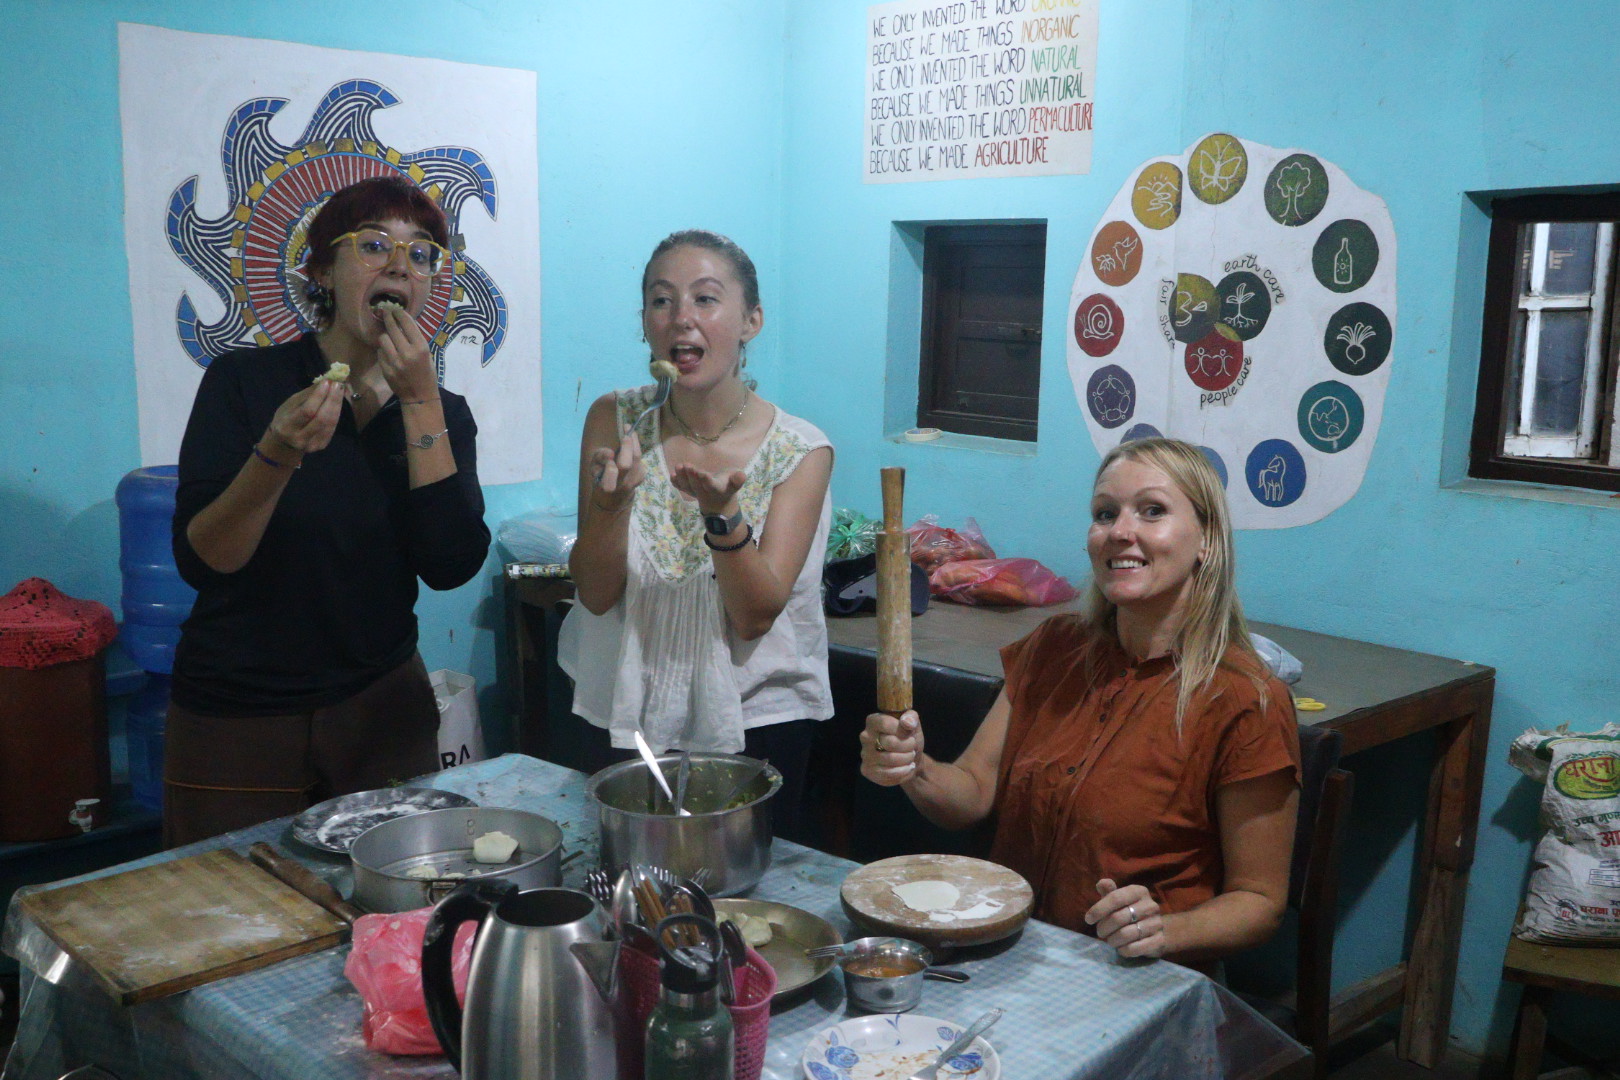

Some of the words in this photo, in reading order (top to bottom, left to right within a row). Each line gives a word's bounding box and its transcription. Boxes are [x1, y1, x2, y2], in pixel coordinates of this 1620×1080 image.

[872, 37, 915, 66] BECAUSE
[920, 33, 936, 55] WE
[941, 29, 970, 54] MADE
[977, 20, 1014, 48] THINGS
[1021, 14, 1081, 43] INORGANIC
[873, 16, 886, 37] WE
[893, 13, 917, 35] ONLY
[922, 2, 966, 28] INVENTED
[970, 0, 987, 20] THE
[872, 69, 886, 92] WE
[890, 63, 916, 90] ONLY
[920, 56, 966, 85] INVENTED
[969, 54, 989, 79] THE
[994, 47, 1026, 75] WORD
[1031, 45, 1081, 74] NATURAL
[871, 92, 914, 120] BECAUSE
[919, 90, 933, 115] WE
[939, 85, 967, 112] MADE
[974, 78, 1015, 108] THINGS
[1020, 72, 1087, 104] UNNATURAL
[871, 123, 885, 146] WE
[891, 119, 917, 145] ONLY
[919, 115, 965, 141] INVENTED
[968, 112, 990, 138] THE
[993, 107, 1027, 137] WORD
[869, 147, 912, 174] BECAUSE
[919, 145, 934, 171] WE
[939, 143, 968, 169] MADE
[974, 136, 1049, 168] AGRICULTURE
[1160, 278, 1175, 306] fair
[1224, 254, 1261, 272] earth
[1263, 269, 1285, 304] care
[1200, 387, 1238, 409] people
[1236, 356, 1252, 386] care
